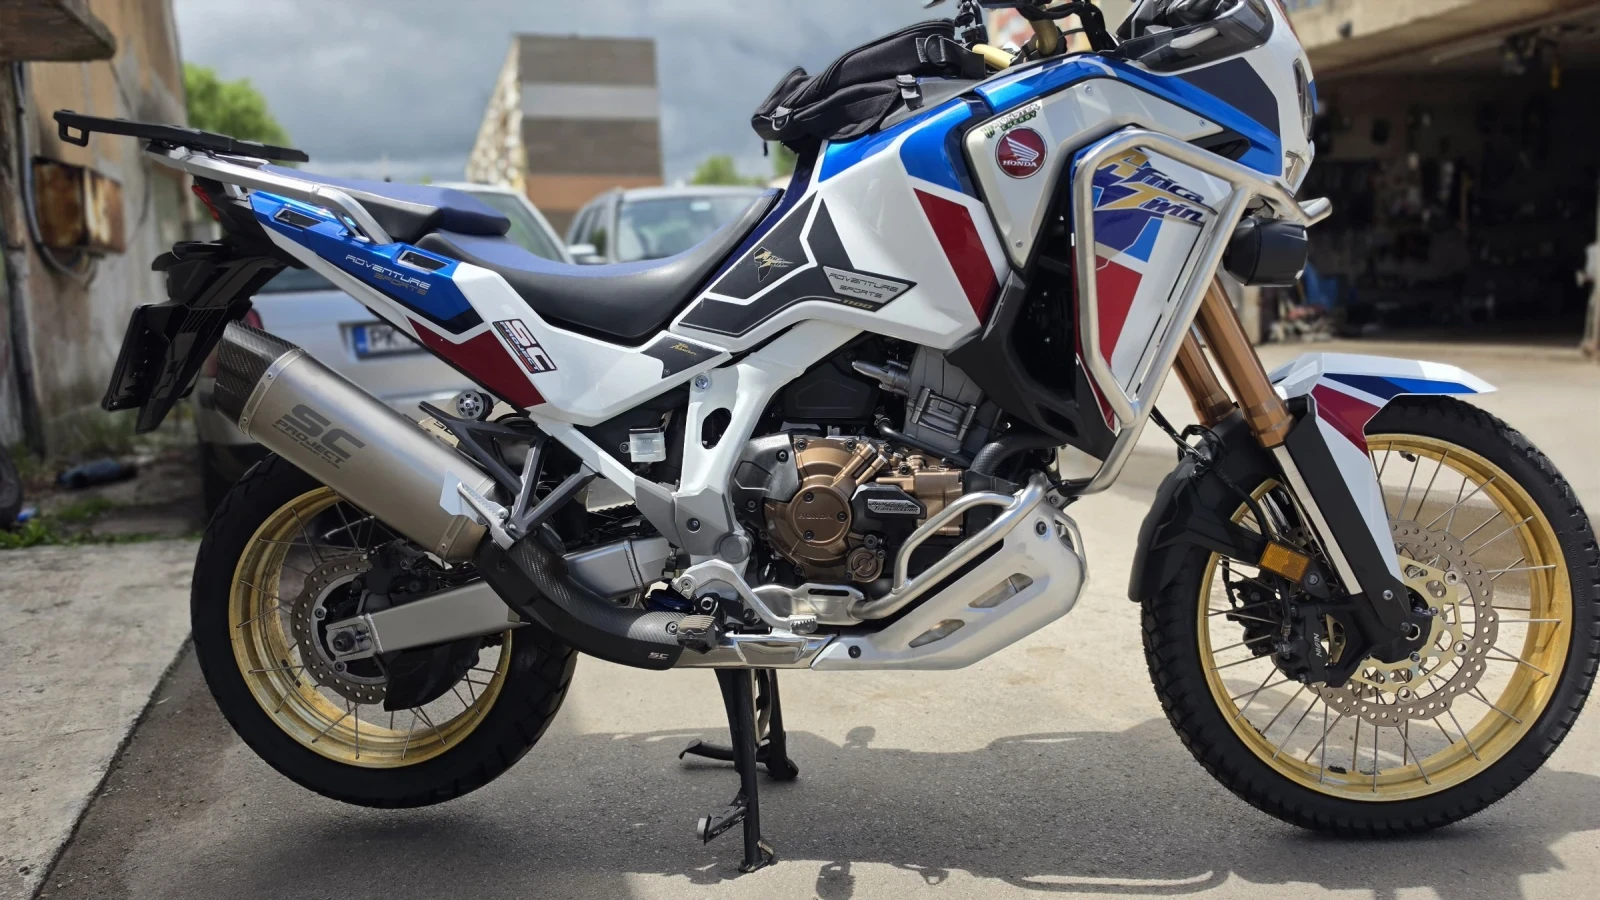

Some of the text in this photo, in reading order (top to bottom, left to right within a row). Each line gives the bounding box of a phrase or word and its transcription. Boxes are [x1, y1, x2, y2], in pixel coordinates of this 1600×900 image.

[1001, 110, 1037, 131] ENERGY
[1002, 159, 1038, 168] HONDA
[345, 254, 431, 290] ADVENTURE
[829, 272, 899, 293] ADVENTURE
[373, 272, 428, 296] SPORTS
[839, 284, 883, 299] SPORTS
[504, 320, 556, 372] SC
[275, 418, 345, 464] PROJECT
[281, 403, 366, 461] SC
[648, 652, 669, 660] SC
